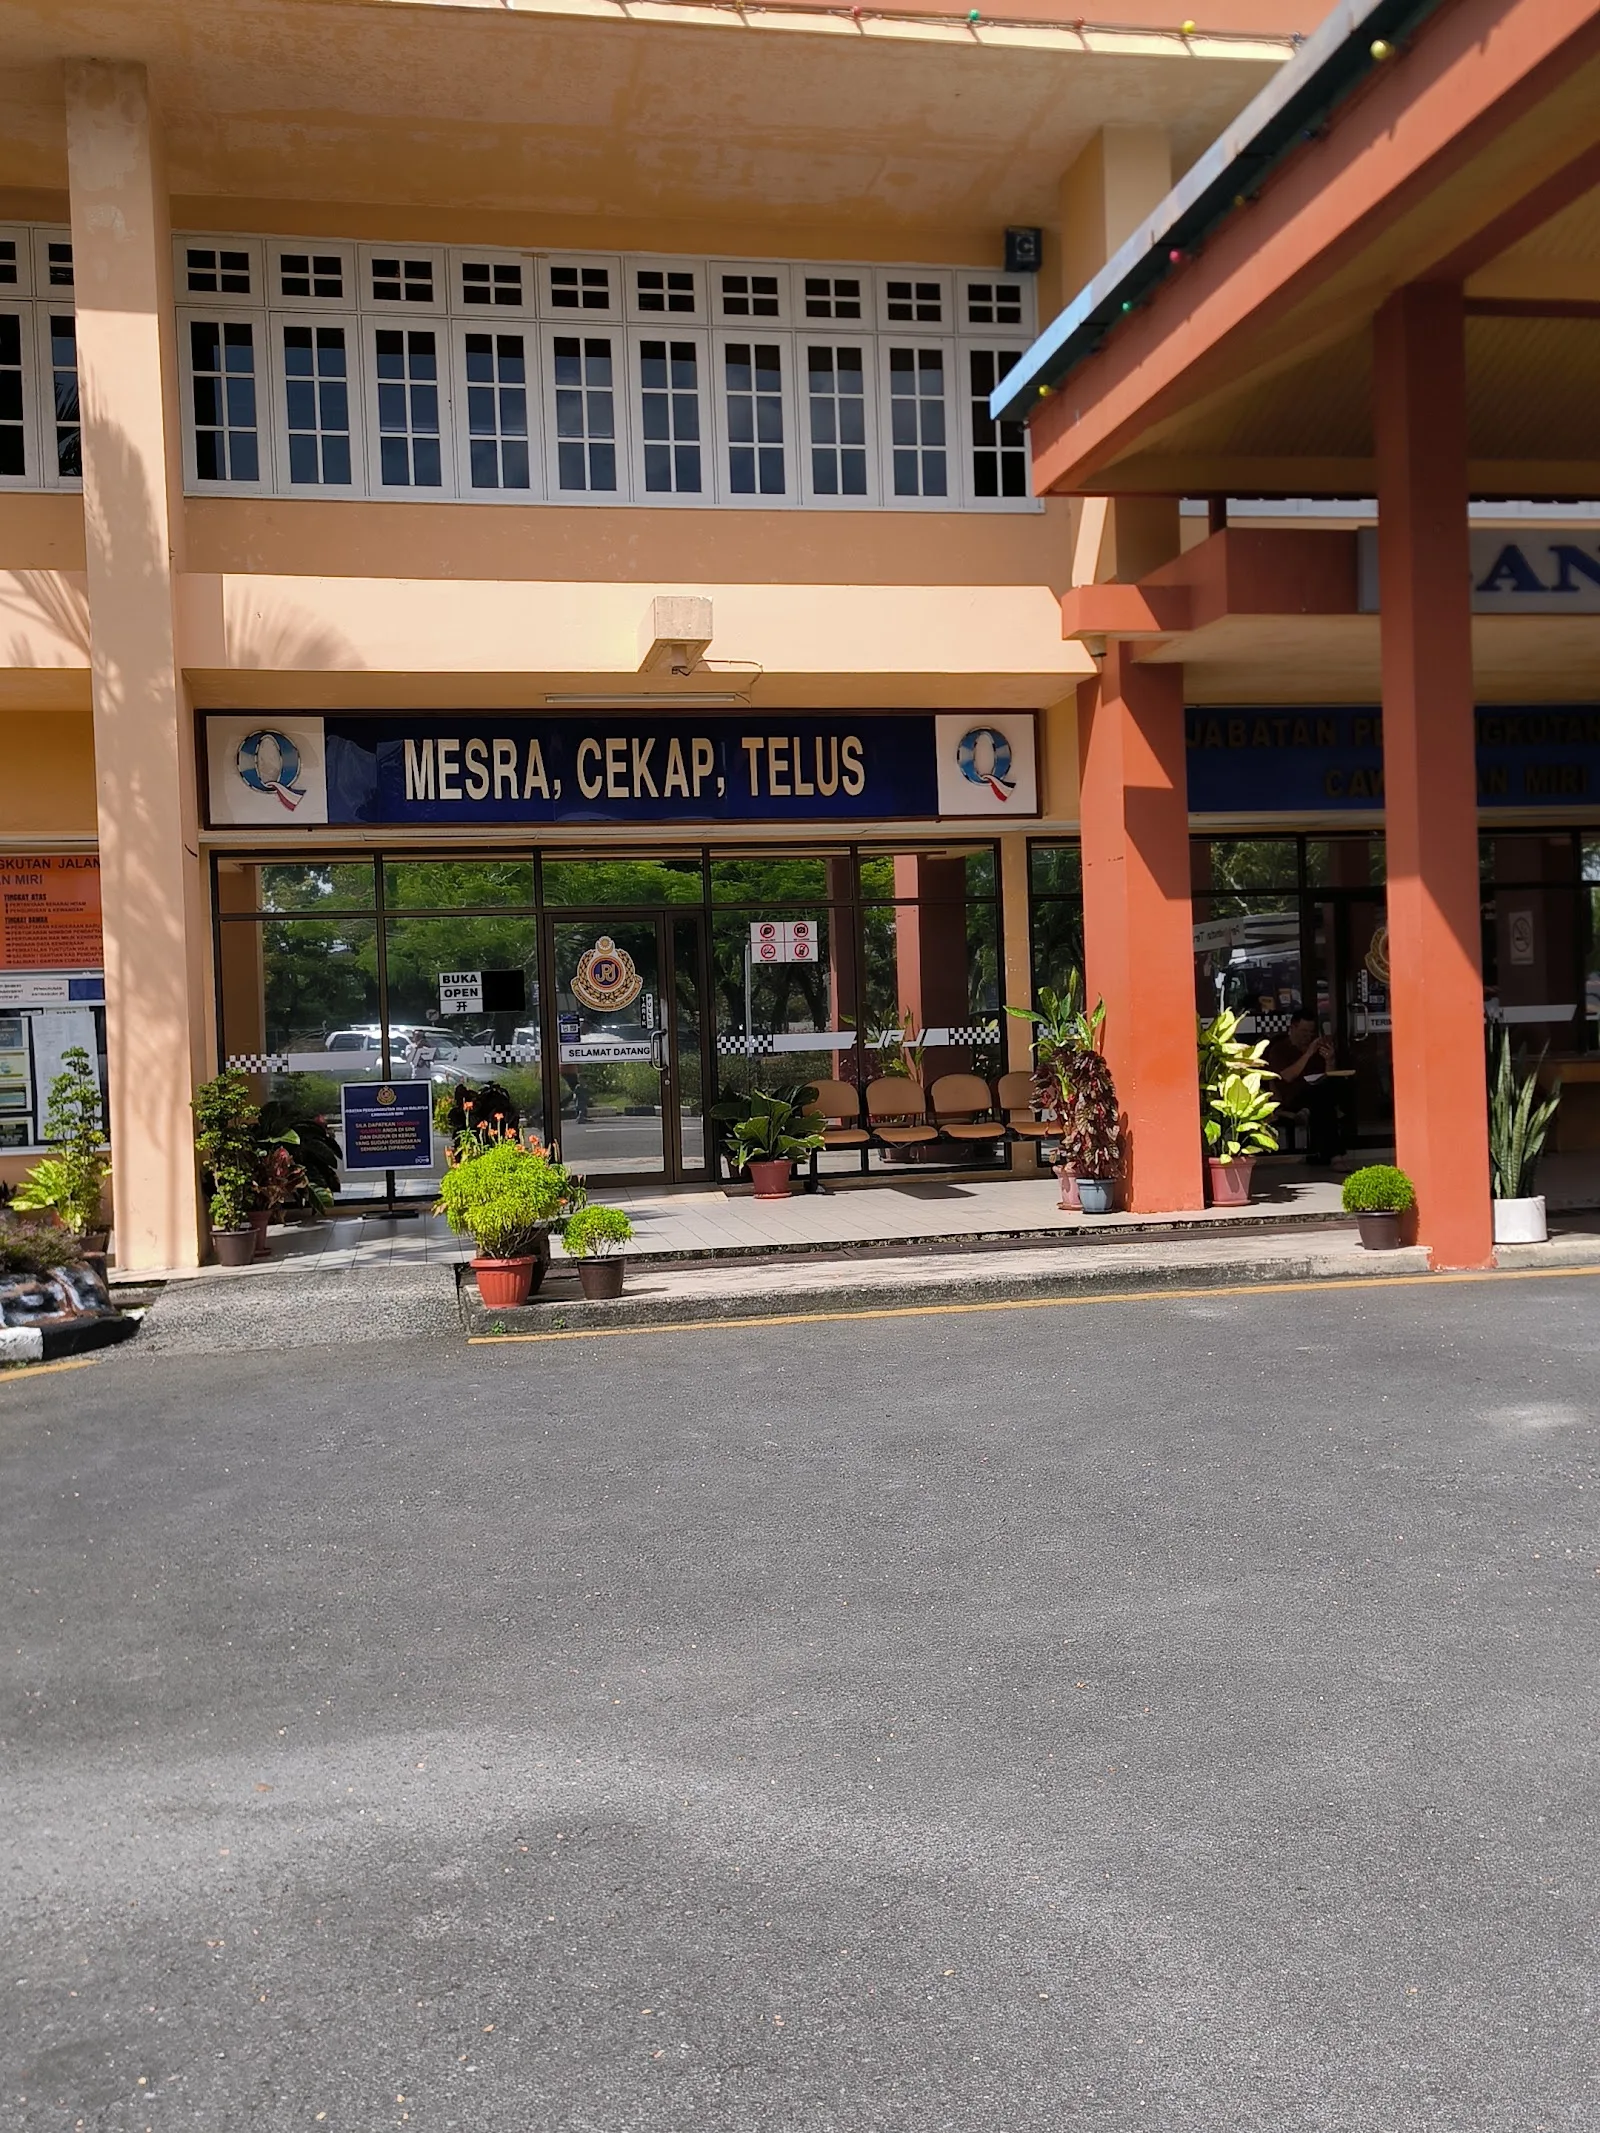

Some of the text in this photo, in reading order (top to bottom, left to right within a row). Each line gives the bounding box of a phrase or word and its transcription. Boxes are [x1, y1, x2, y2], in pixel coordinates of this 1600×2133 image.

[1187, 717, 1337, 748] JABATAN
[404, 735, 865, 800] MESRA, CEKAP, TELUS
[1524, 765, 1588, 794] MIRI
[58, 858, 101, 869] JALAN
[15, 874, 43, 885] MIRI
[443, 975, 477, 983] BUKA
[444, 988, 478, 998] OPEN
[569, 1047, 650, 1057] SELAMAT DATANG
